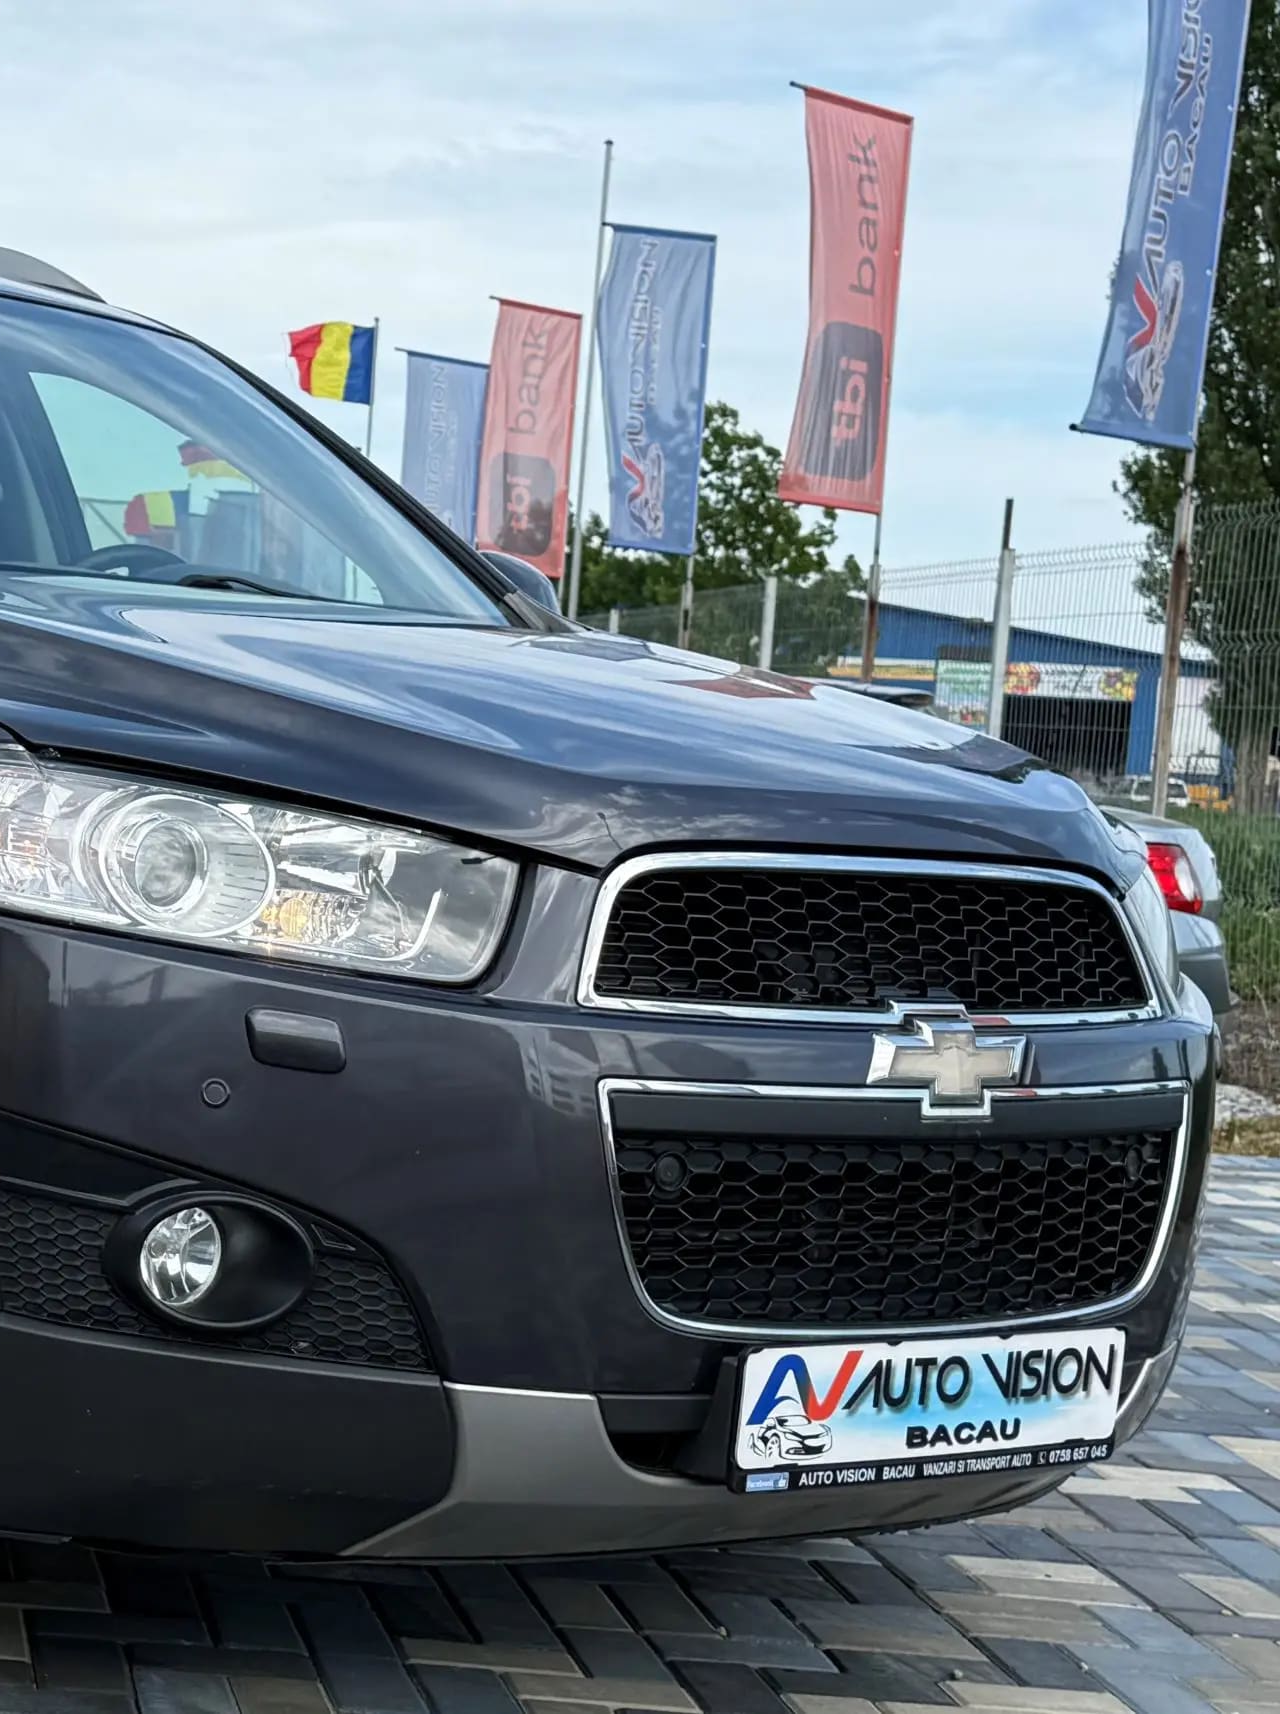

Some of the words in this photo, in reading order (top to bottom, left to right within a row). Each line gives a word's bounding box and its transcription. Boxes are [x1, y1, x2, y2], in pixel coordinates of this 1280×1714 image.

[1178, 32, 1212, 196] BACAU
[848, 132, 878, 297] bank
[1143, 130, 1183, 297] AUTO
[508, 323, 549, 436] bank
[625, 367, 645, 464] AUTO
[831, 355, 869, 447] tbi
[506, 473, 531, 534] tbi
[842, 1355, 970, 1411] AUTO
[981, 1343, 1116, 1399] VISION
[798, 1470, 834, 1487] AUTO
[836, 1466, 876, 1484] VISION
[882, 1463, 916, 1480] BACAU
[923, 1458, 956, 1477] VANZARI
[957, 1458, 965, 1473] SI
[966, 1454, 1010, 1472] TRANSPORT
[1011, 1452, 1032, 1467] AUTO
[1049, 1449, 1071, 1463] 0758
[1073, 1447, 1088, 1461] 657
[1091, 1444, 1107, 1459] 045
[906, 1417, 1021, 1449] BACAU
